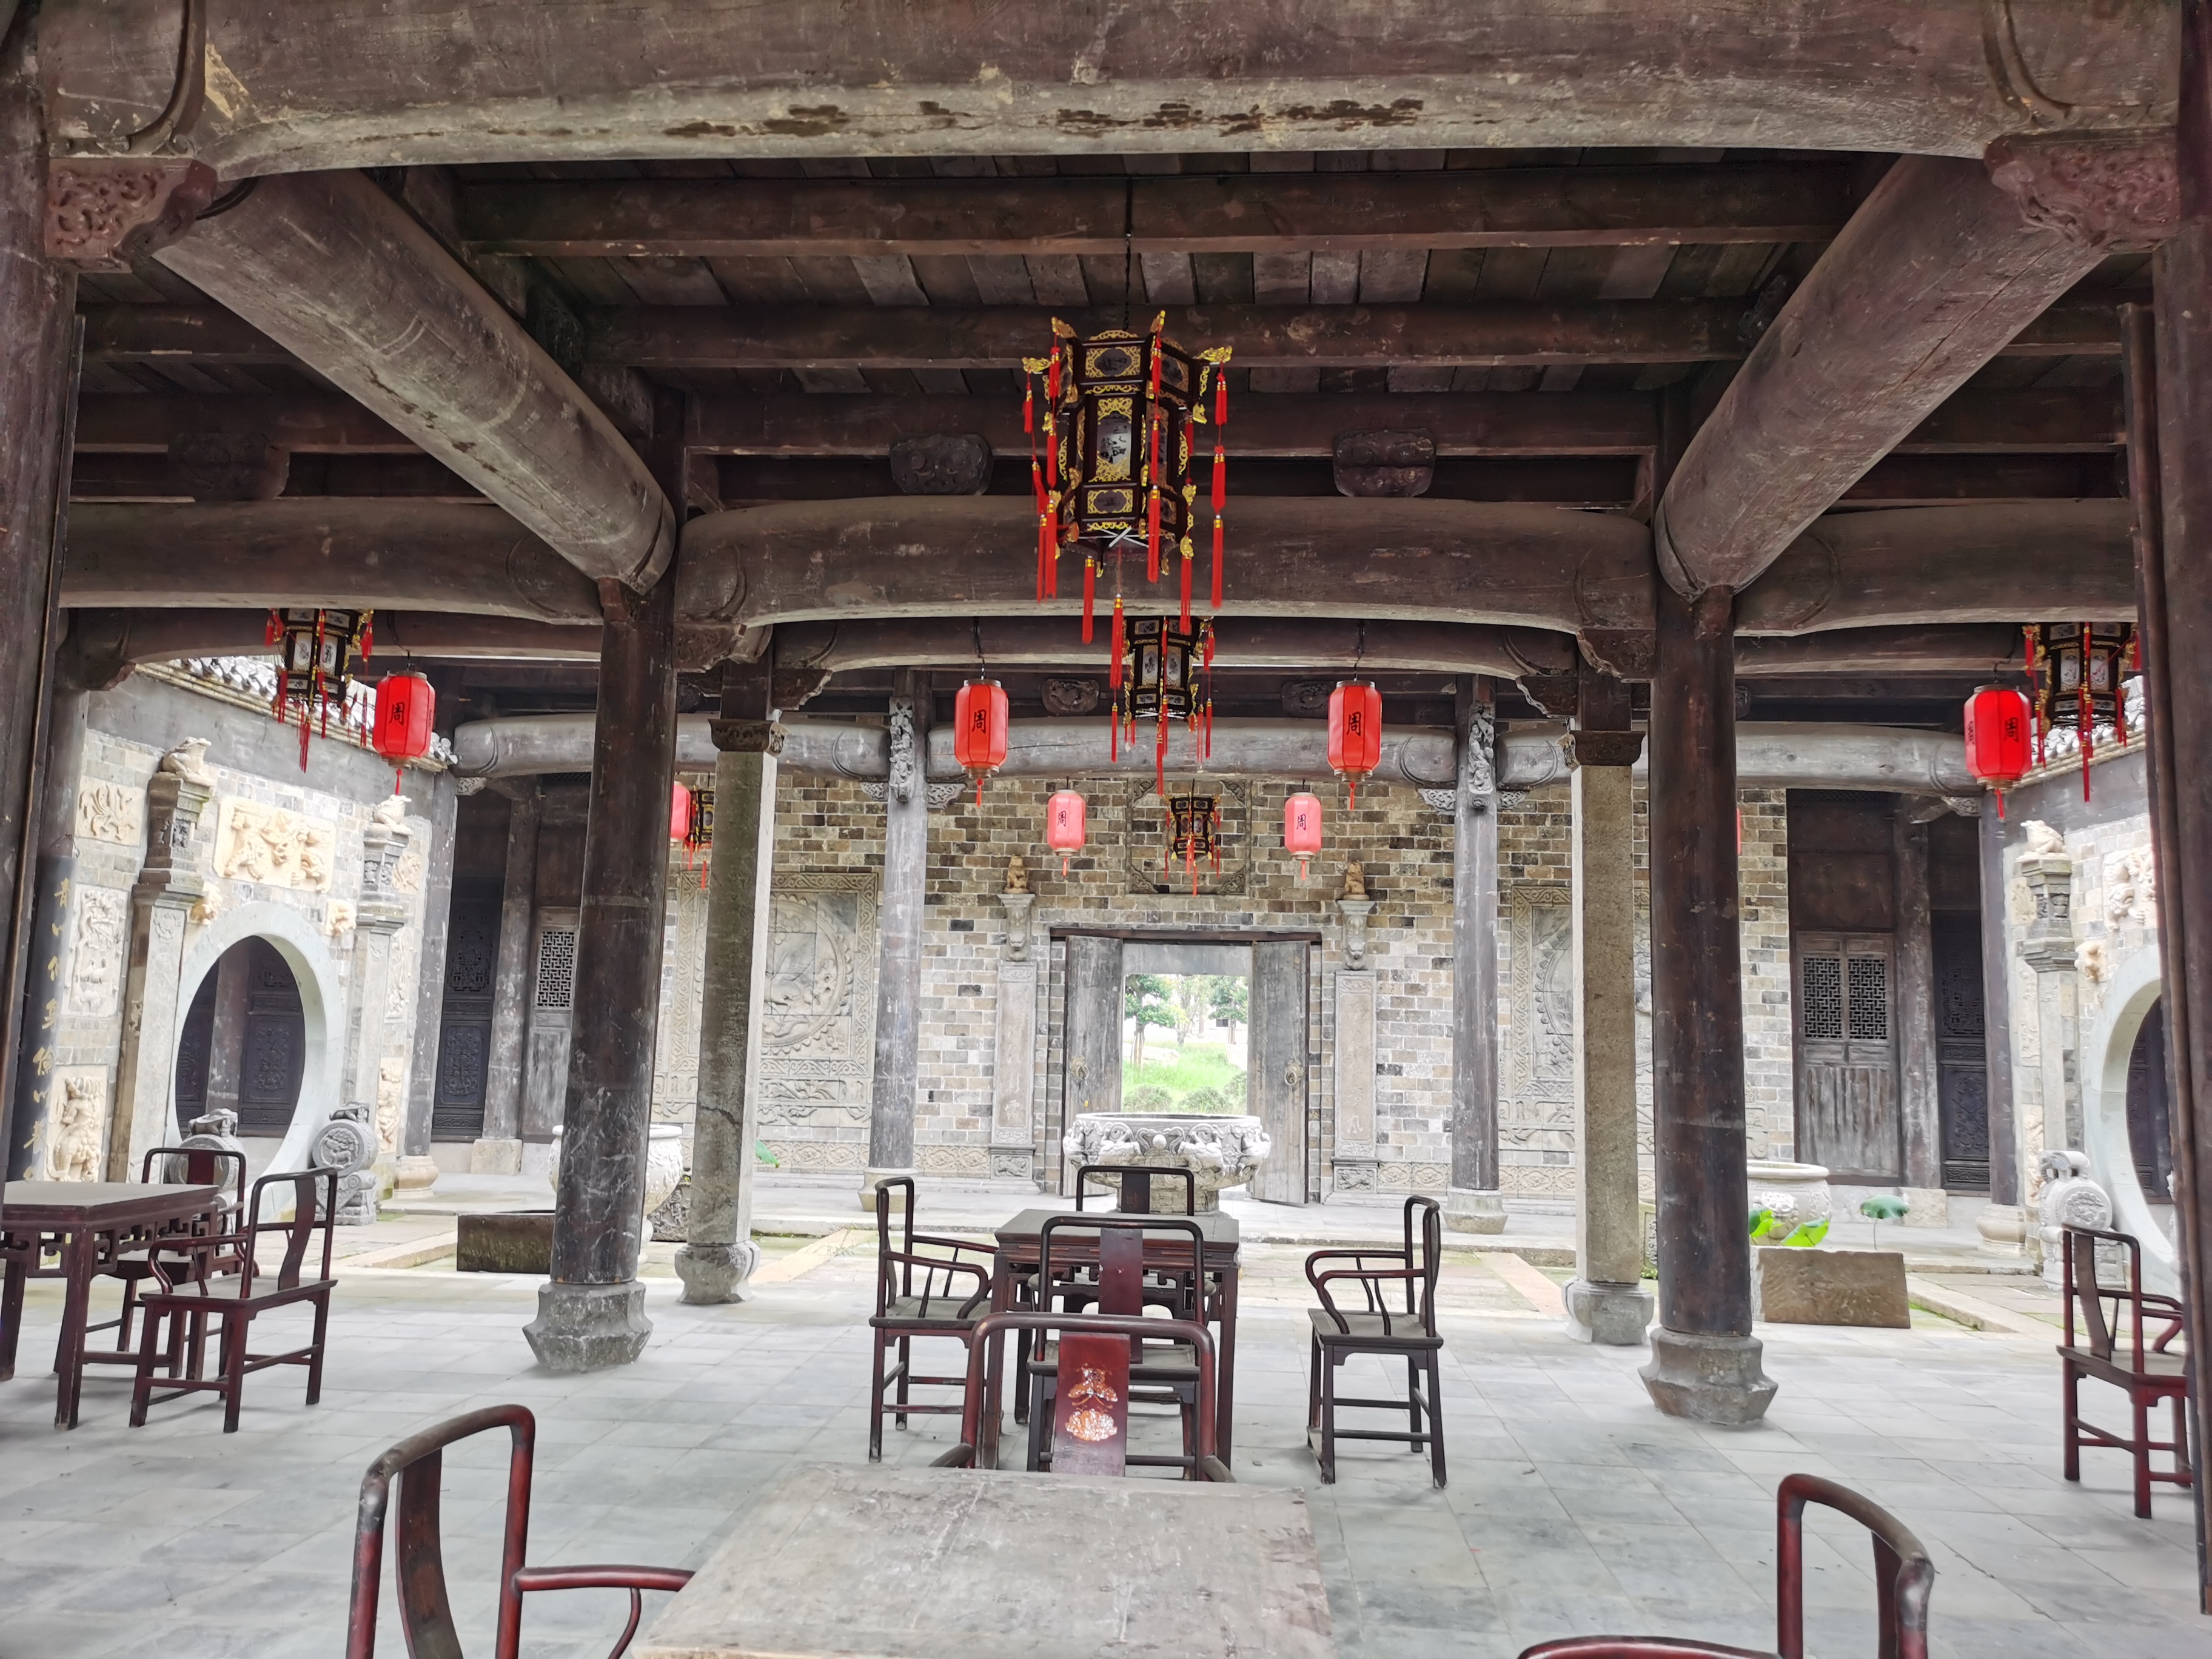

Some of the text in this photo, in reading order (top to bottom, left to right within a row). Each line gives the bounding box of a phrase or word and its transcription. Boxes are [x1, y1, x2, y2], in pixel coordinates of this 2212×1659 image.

[389, 702, 405, 726] 周
[971, 709, 987, 734] 周
[1347, 711, 1362, 737] 周
[2003, 717, 2019, 742] 周
[1057, 810, 1067, 827] 周
[1296, 814, 1307, 831] 周
